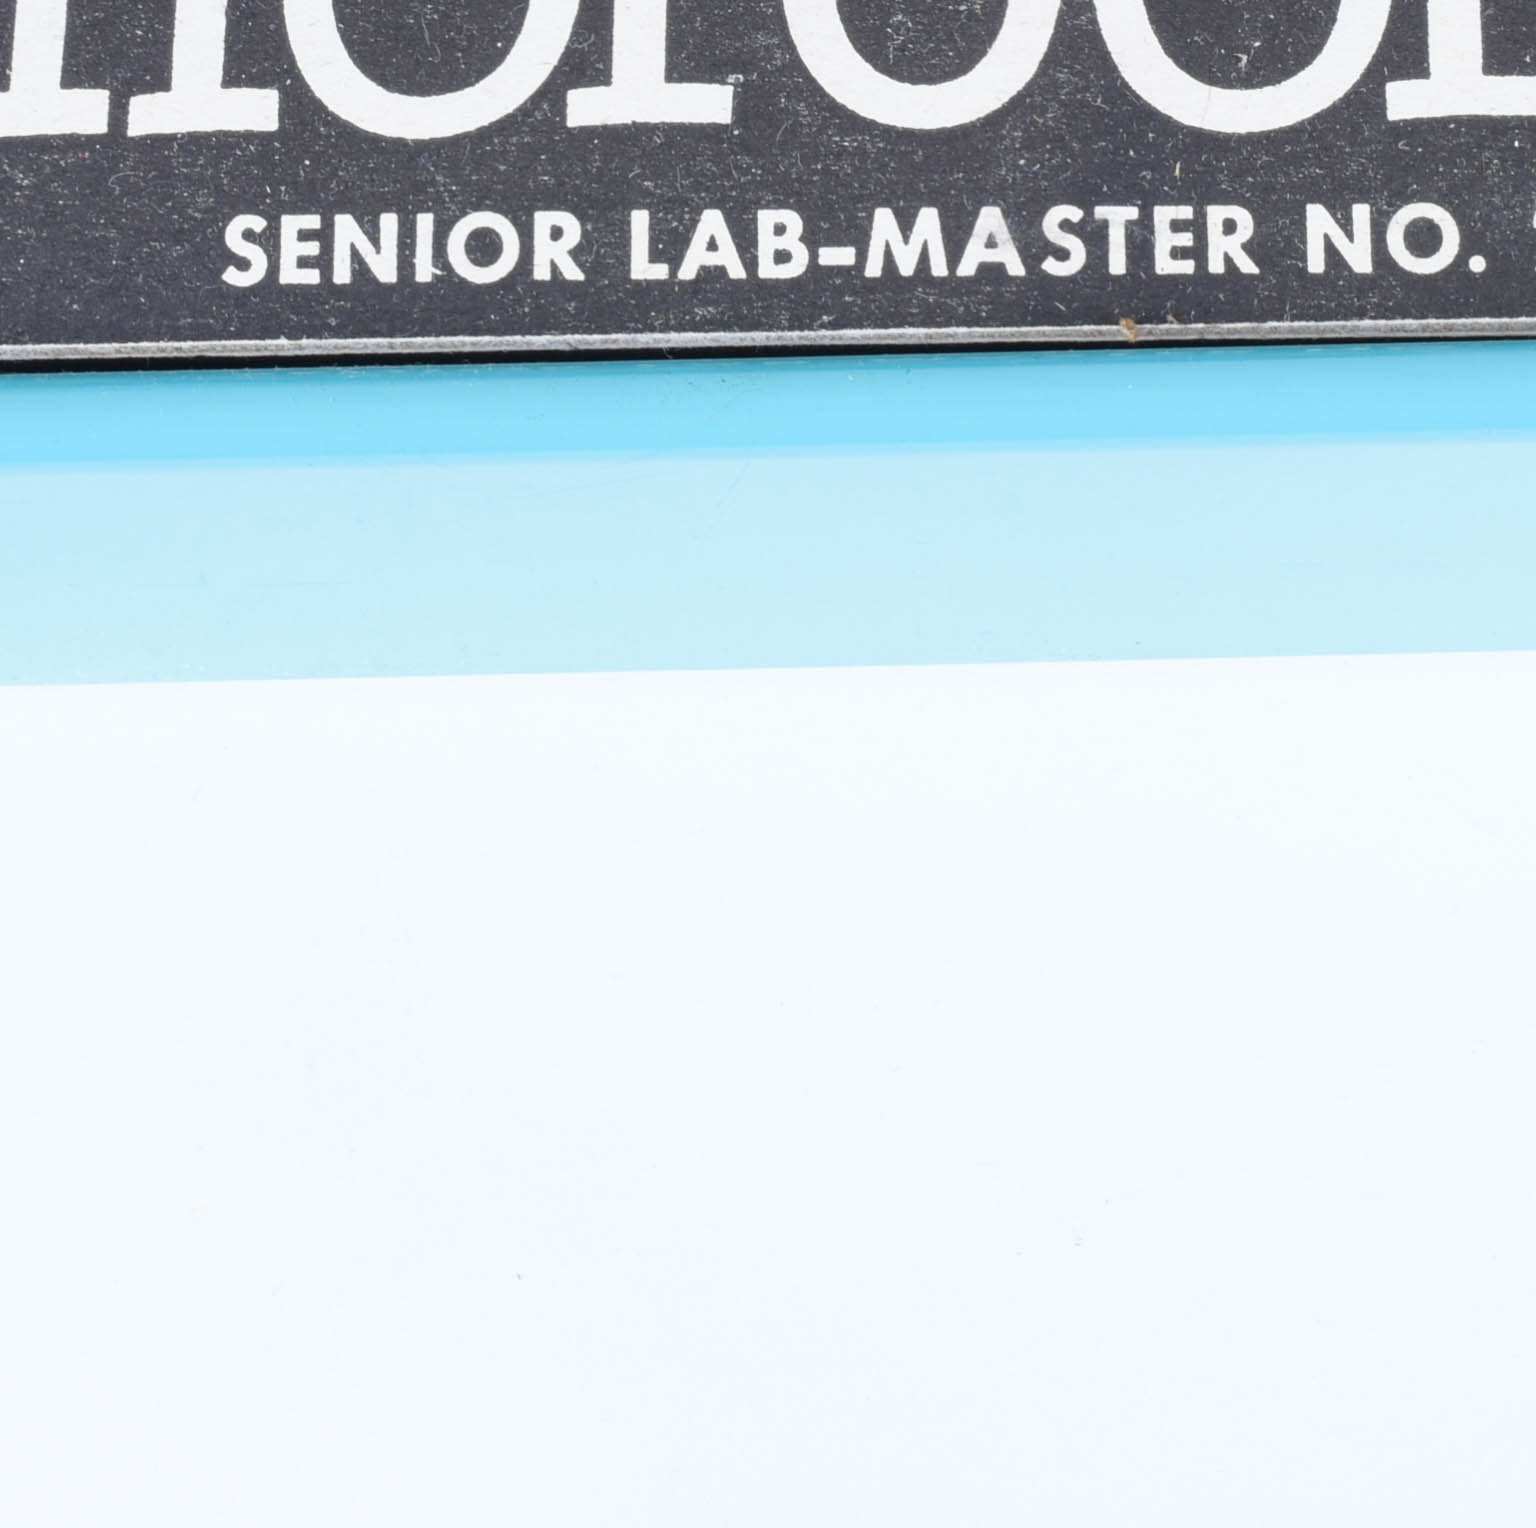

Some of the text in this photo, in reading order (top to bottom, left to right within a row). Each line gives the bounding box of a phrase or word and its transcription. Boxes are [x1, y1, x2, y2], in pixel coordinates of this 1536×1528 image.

[219, 209, 587, 289] SENIOR
[627, 203, 1262, 282] LAB-MASTER
[1304, 200, 1488, 276] NO.
